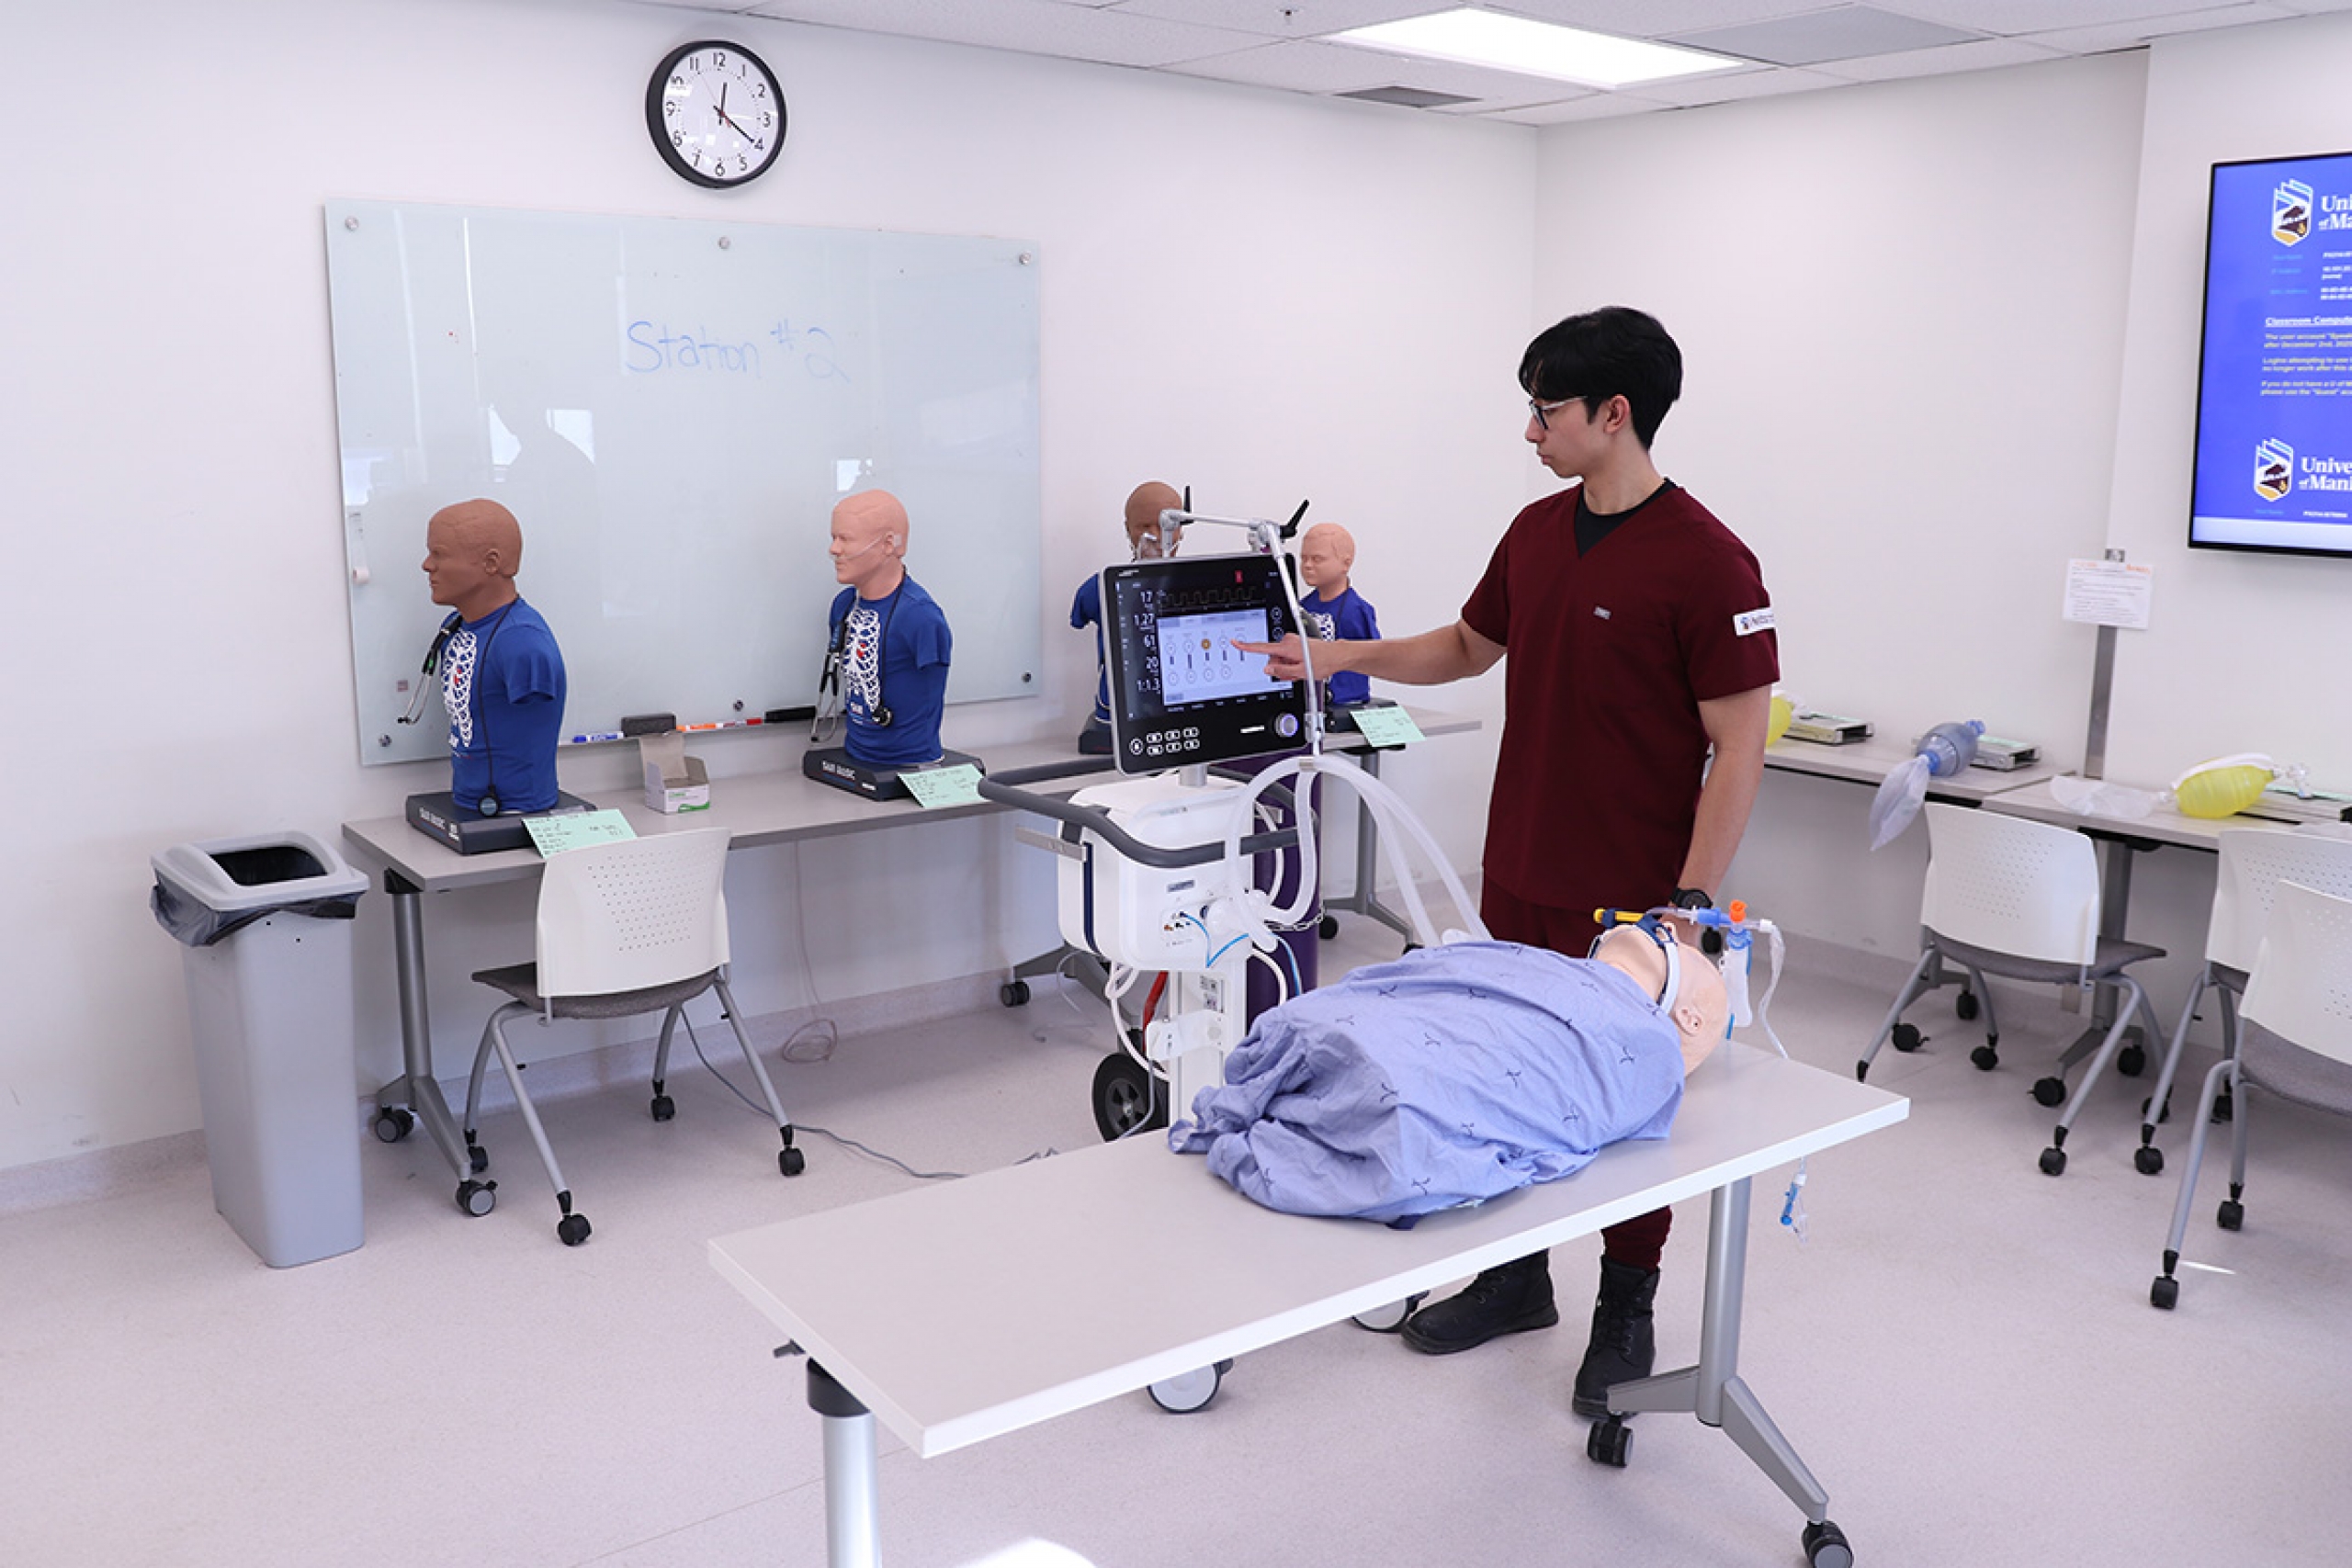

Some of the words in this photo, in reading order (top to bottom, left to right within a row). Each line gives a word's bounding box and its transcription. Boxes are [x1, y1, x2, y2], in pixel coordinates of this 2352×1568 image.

[689, 56, 698, 71] 11
[713, 52, 726, 67] 12
[758, 83, 765, 98] 2
[666, 100, 675, 117] 9
[763, 111, 771, 128] 3
[754, 137, 763, 151] 4
[692, 152, 700, 167] 7
[739, 156, 747, 172] 5
[716, 162, 726, 176] 6
[626, 321, 761, 378] Station
